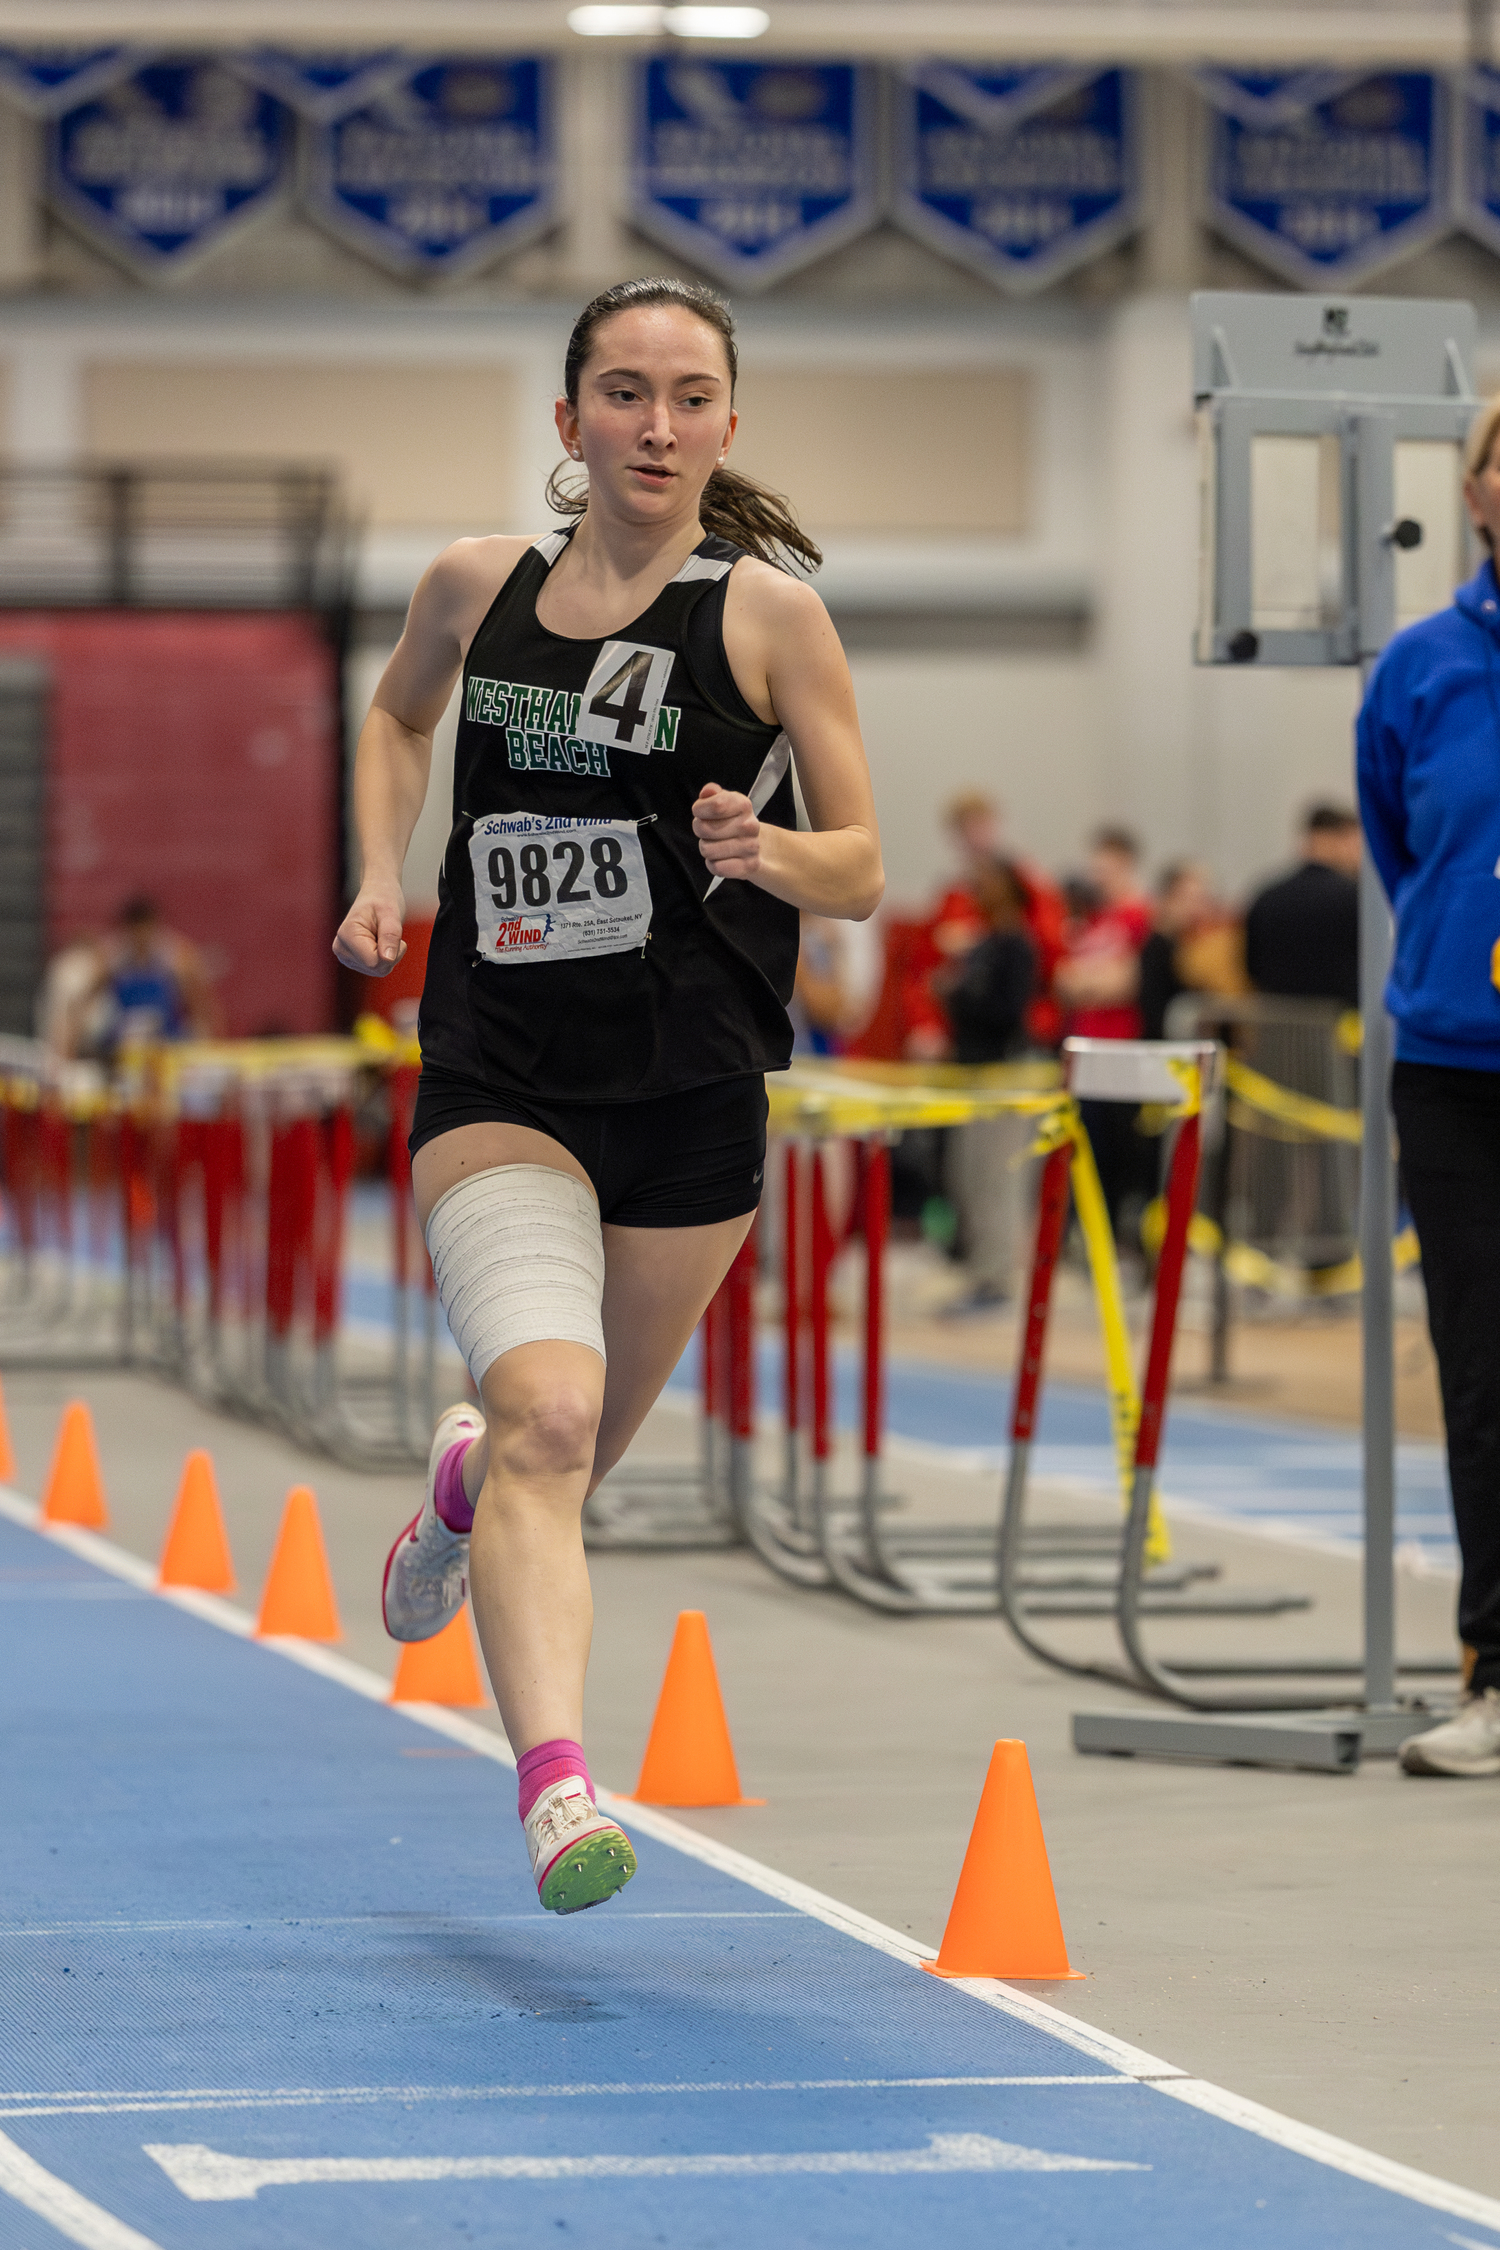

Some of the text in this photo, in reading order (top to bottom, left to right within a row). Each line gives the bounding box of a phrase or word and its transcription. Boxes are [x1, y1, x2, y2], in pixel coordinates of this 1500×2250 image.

[466, 675, 682, 752] WESTHAN
[588, 650, 655, 743] 4
[505, 727, 611, 778] BEACH
[484, 816, 542, 835] Schwab's
[545, 817, 571, 830] 2nd
[487, 836, 628, 910] 9828
[496, 916, 542, 947] 2nd WIND
